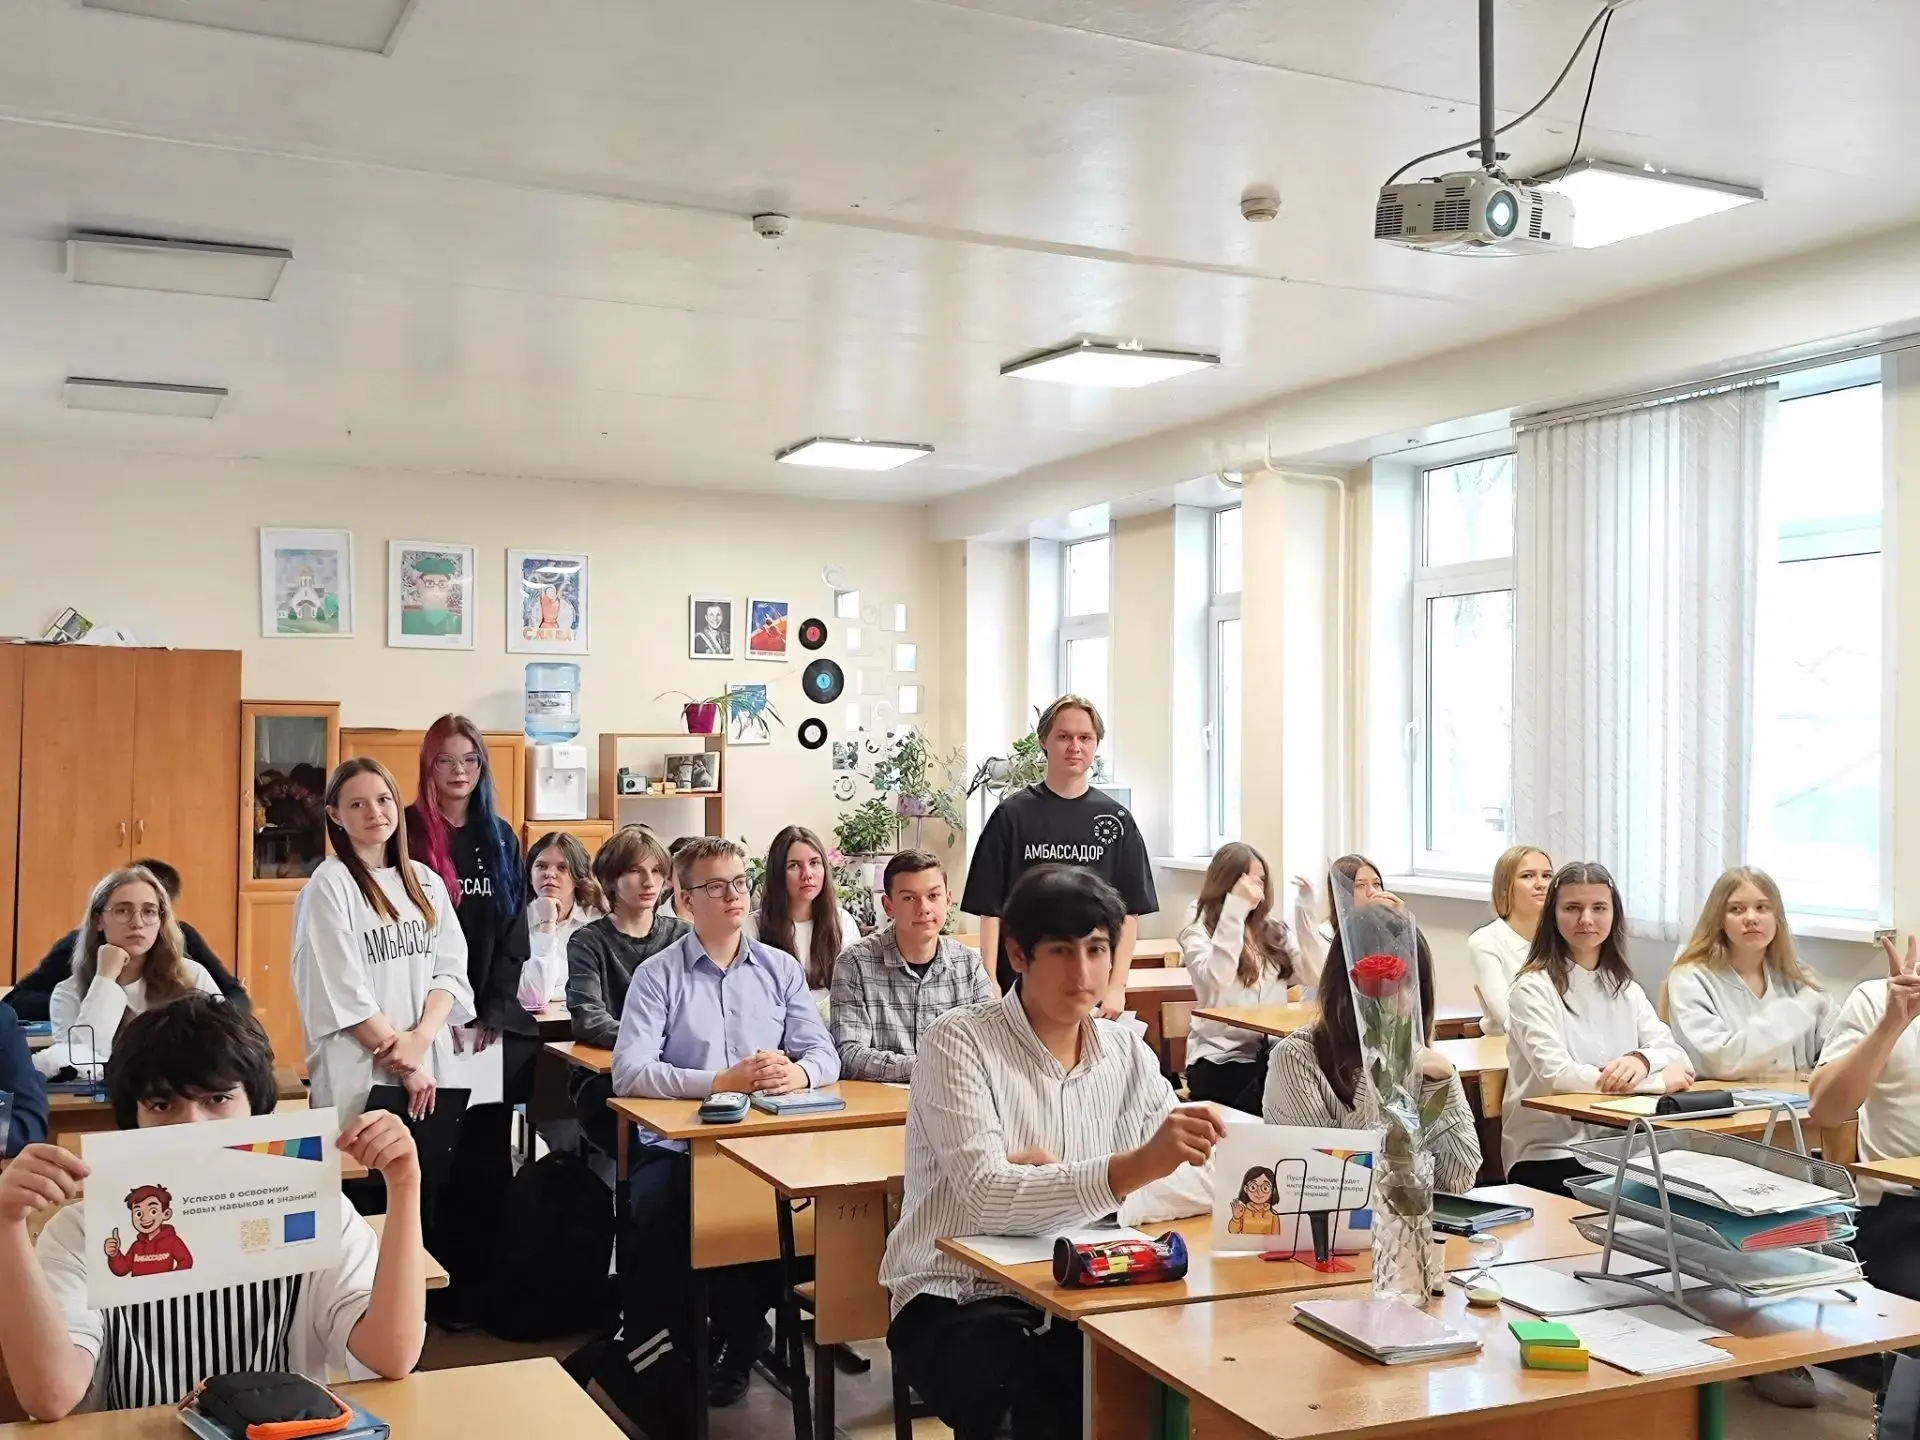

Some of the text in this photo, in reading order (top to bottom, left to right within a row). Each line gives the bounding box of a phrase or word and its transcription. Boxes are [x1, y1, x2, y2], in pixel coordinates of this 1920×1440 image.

[1024, 844, 1104, 862] АМБАССАДОР
[182, 1194, 227, 1205] Успехов
[238, 1185, 289, 1198] освоении
[182, 1206, 217, 1216] новых
[219, 1199, 265, 1211] навыков
[276, 1191, 318, 1204] знаний!
